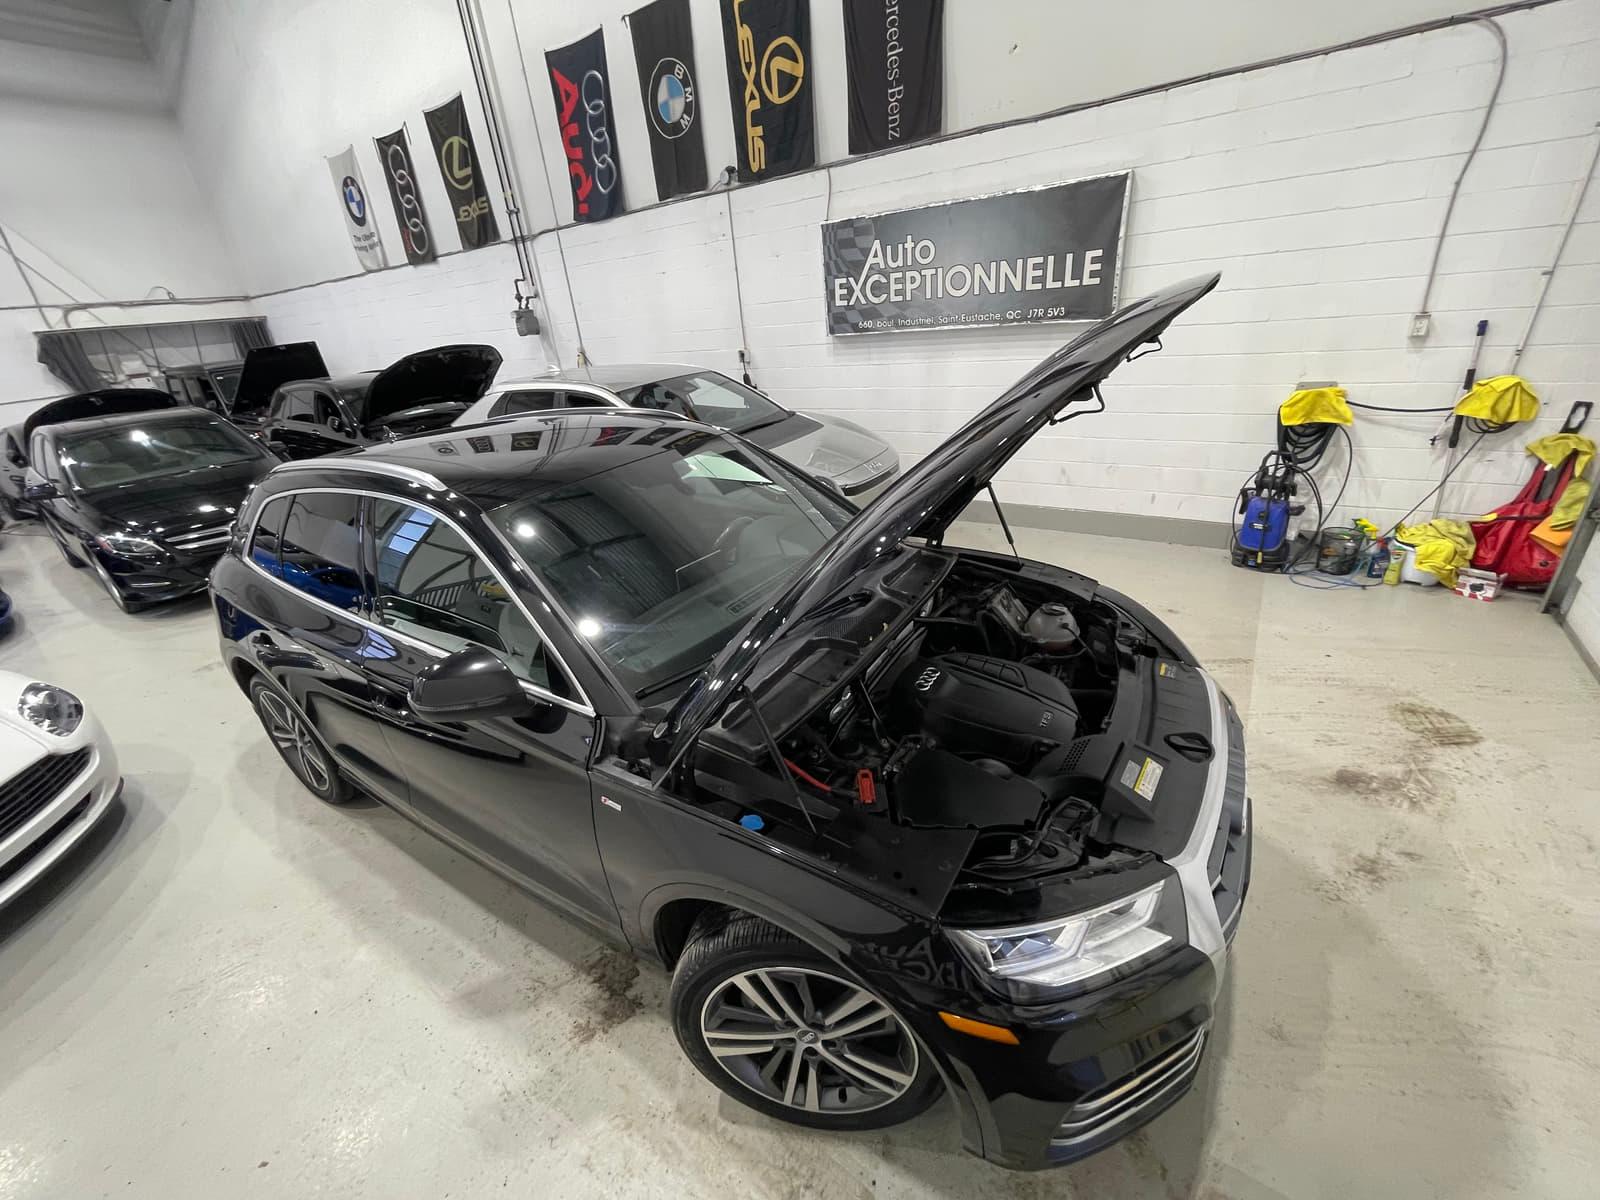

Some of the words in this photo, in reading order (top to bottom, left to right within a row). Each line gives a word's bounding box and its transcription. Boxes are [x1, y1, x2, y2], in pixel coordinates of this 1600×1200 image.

[674, 64, 693, 129] BMW
[886, 0, 904, 140] rcedes-Benz
[834, 248, 1105, 307] EXCEPTIONNELLE
[864, 234, 936, 270] Auto
[1006, 310, 1022, 320] QC
[1027, 308, 1045, 319] J7R
[1047, 306, 1065, 318] 5V3
